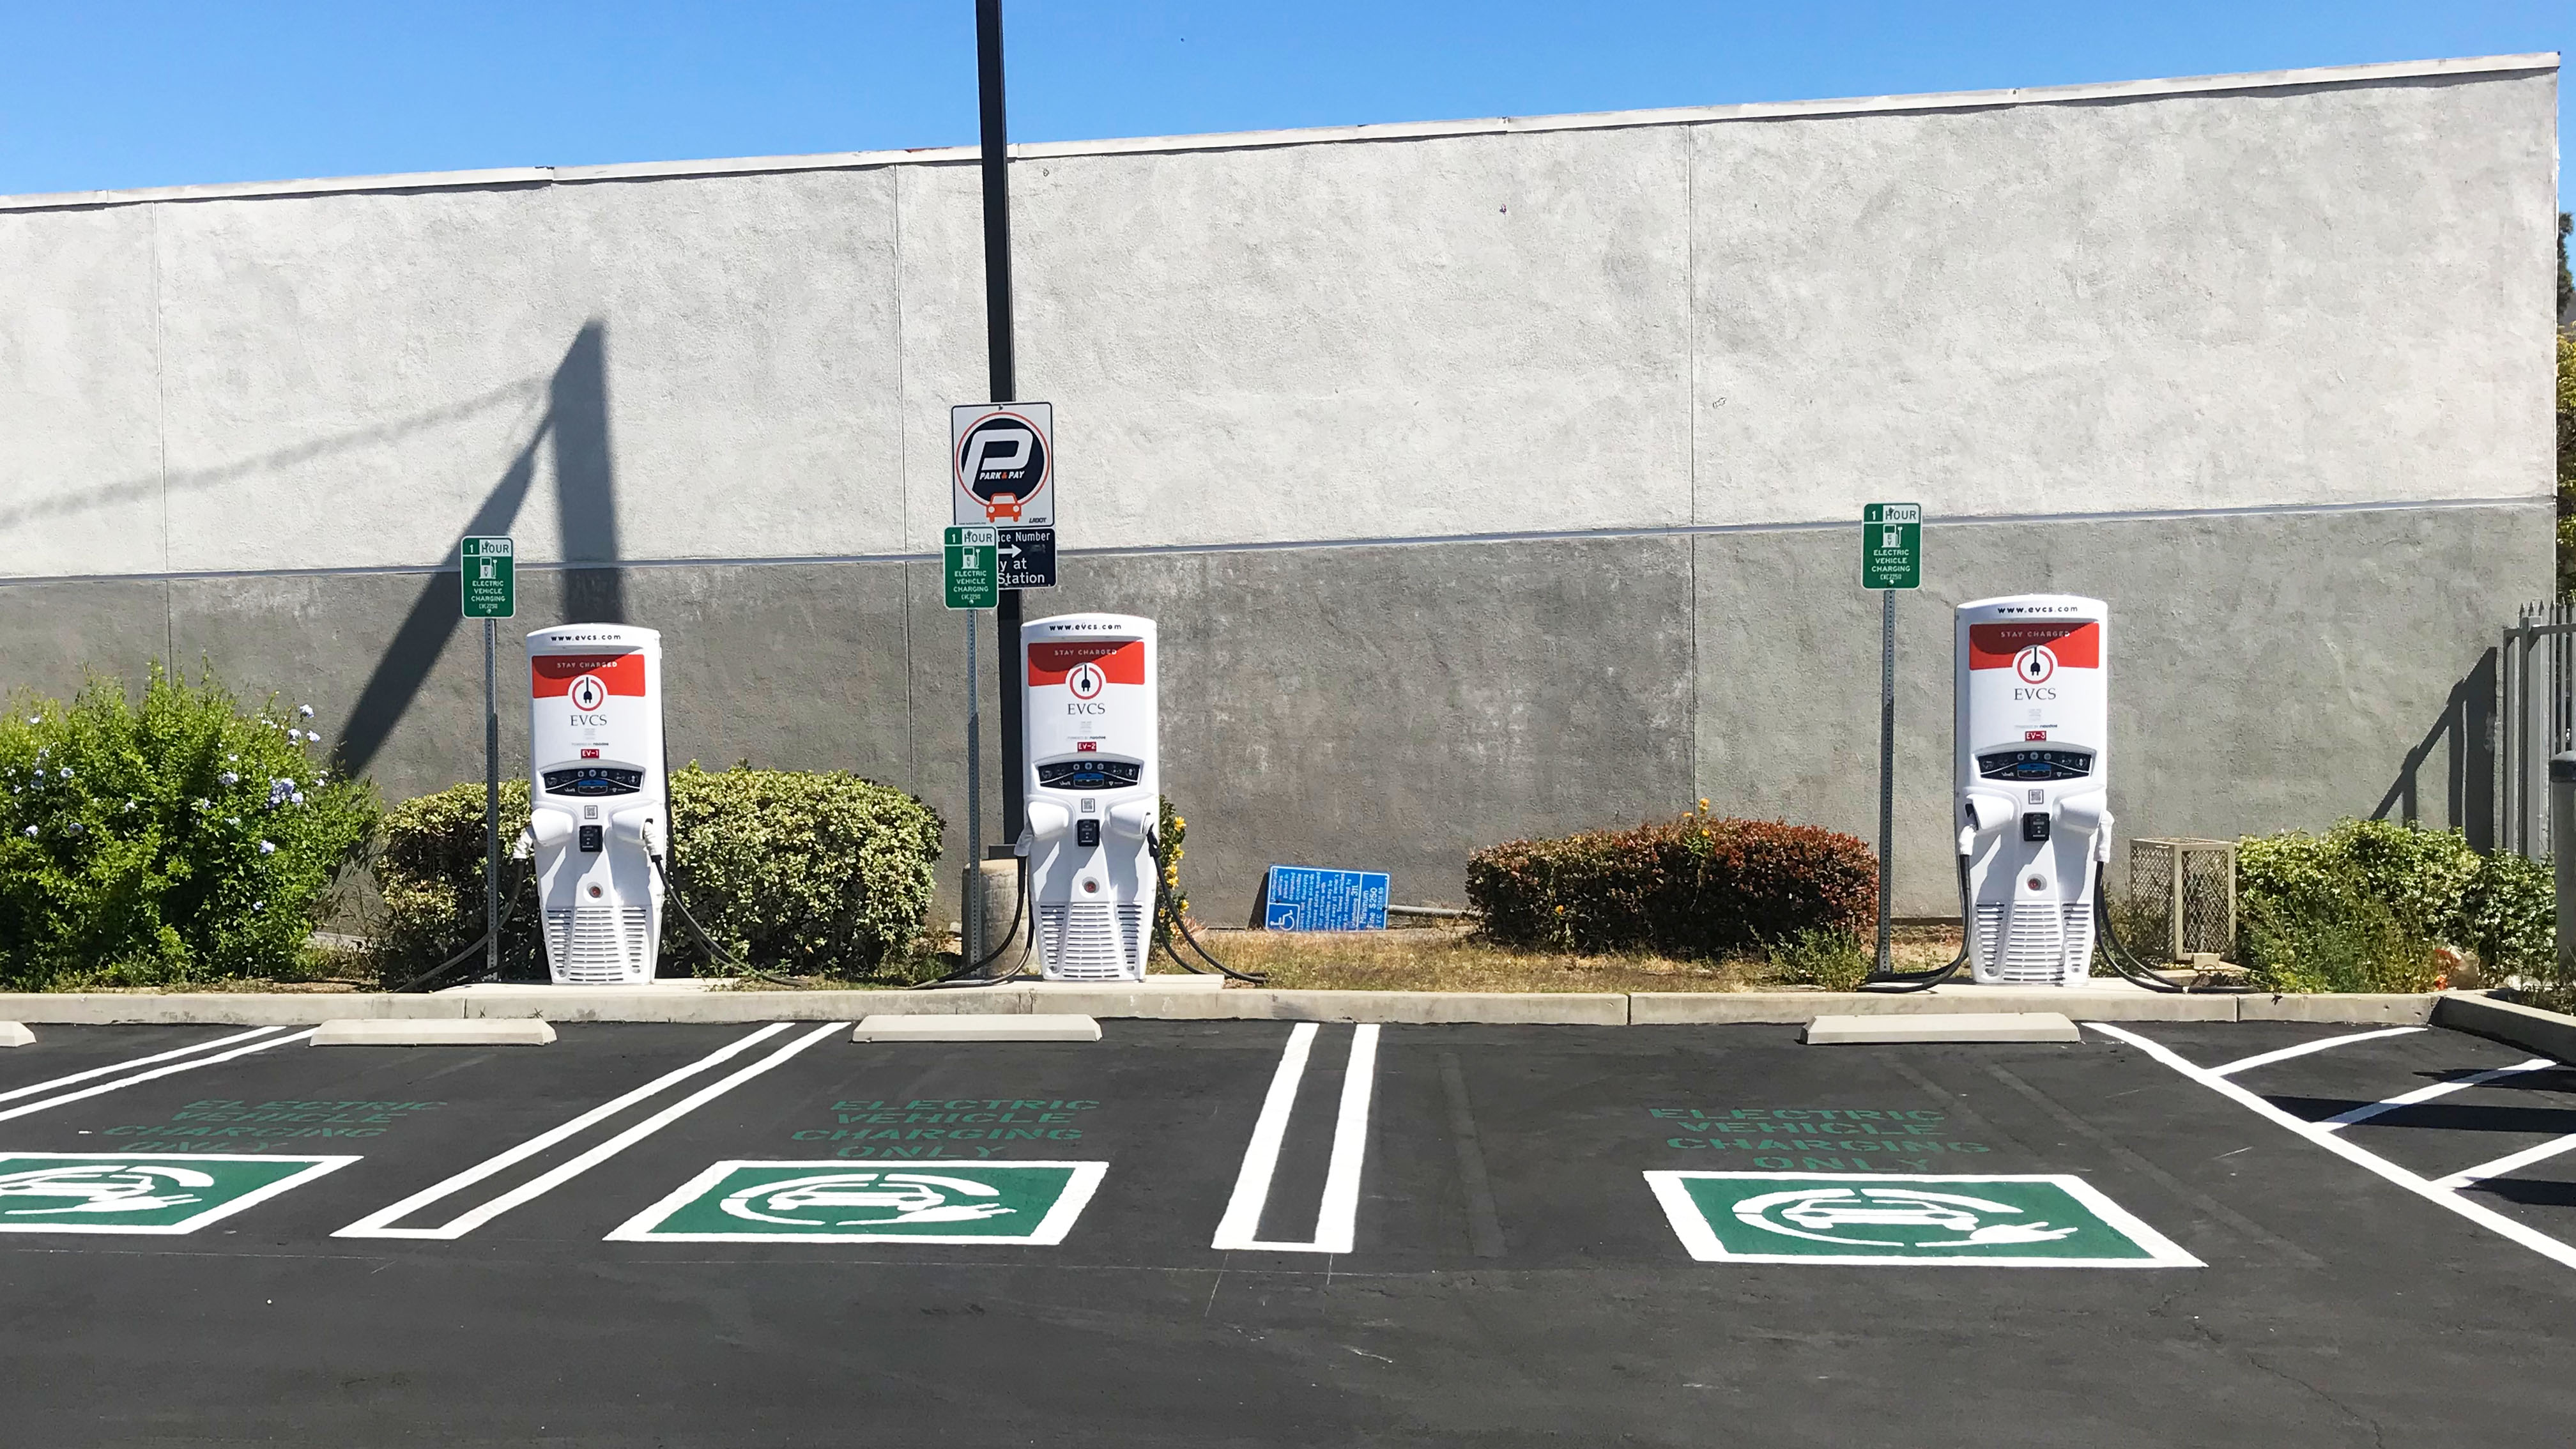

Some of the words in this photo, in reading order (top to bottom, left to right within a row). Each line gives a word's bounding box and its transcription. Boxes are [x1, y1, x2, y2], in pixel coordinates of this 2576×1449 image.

[1872, 510, 1876, 521] 1
[1885, 510, 1917, 520] HOUR
[952, 533, 956, 543] 1
[964, 533, 993, 542] HOUR
[1015, 532, 1050, 542] Number
[470, 544, 473, 554] 1
[482, 544, 509, 553] HOUR
[1013, 558, 1027, 569] at
[998, 572, 1045, 584] Station
[1997, 606, 2078, 614] www.evcs.com
[2014, 687, 2057, 701] EVCS
[1067, 703, 1106, 715] EVCS
[570, 714, 608, 726] EVCS
[1360, 890, 1369, 924] Minimum
[1367, 912, 1376, 928] Fine
[183, 1100, 448, 1111] ELECTRIC
[829, 1100, 1101, 1110] ELECTRIC
[171, 1112, 409, 1123] VEHICLE
[837, 1112, 1076, 1124] VEHICLE
[1648, 1108, 1945, 1121] ELECTRIC
[102, 1125, 388, 1137] CHARGING
[790, 1128, 1083, 1140] CHARGING
[1677, 1121, 1948, 1135] VEHICLE
[1666, 1137, 1991, 1153] CHARGING
[836, 1146, 1007, 1158] ONLY
[1752, 1156, 1929, 1172] ONLY
